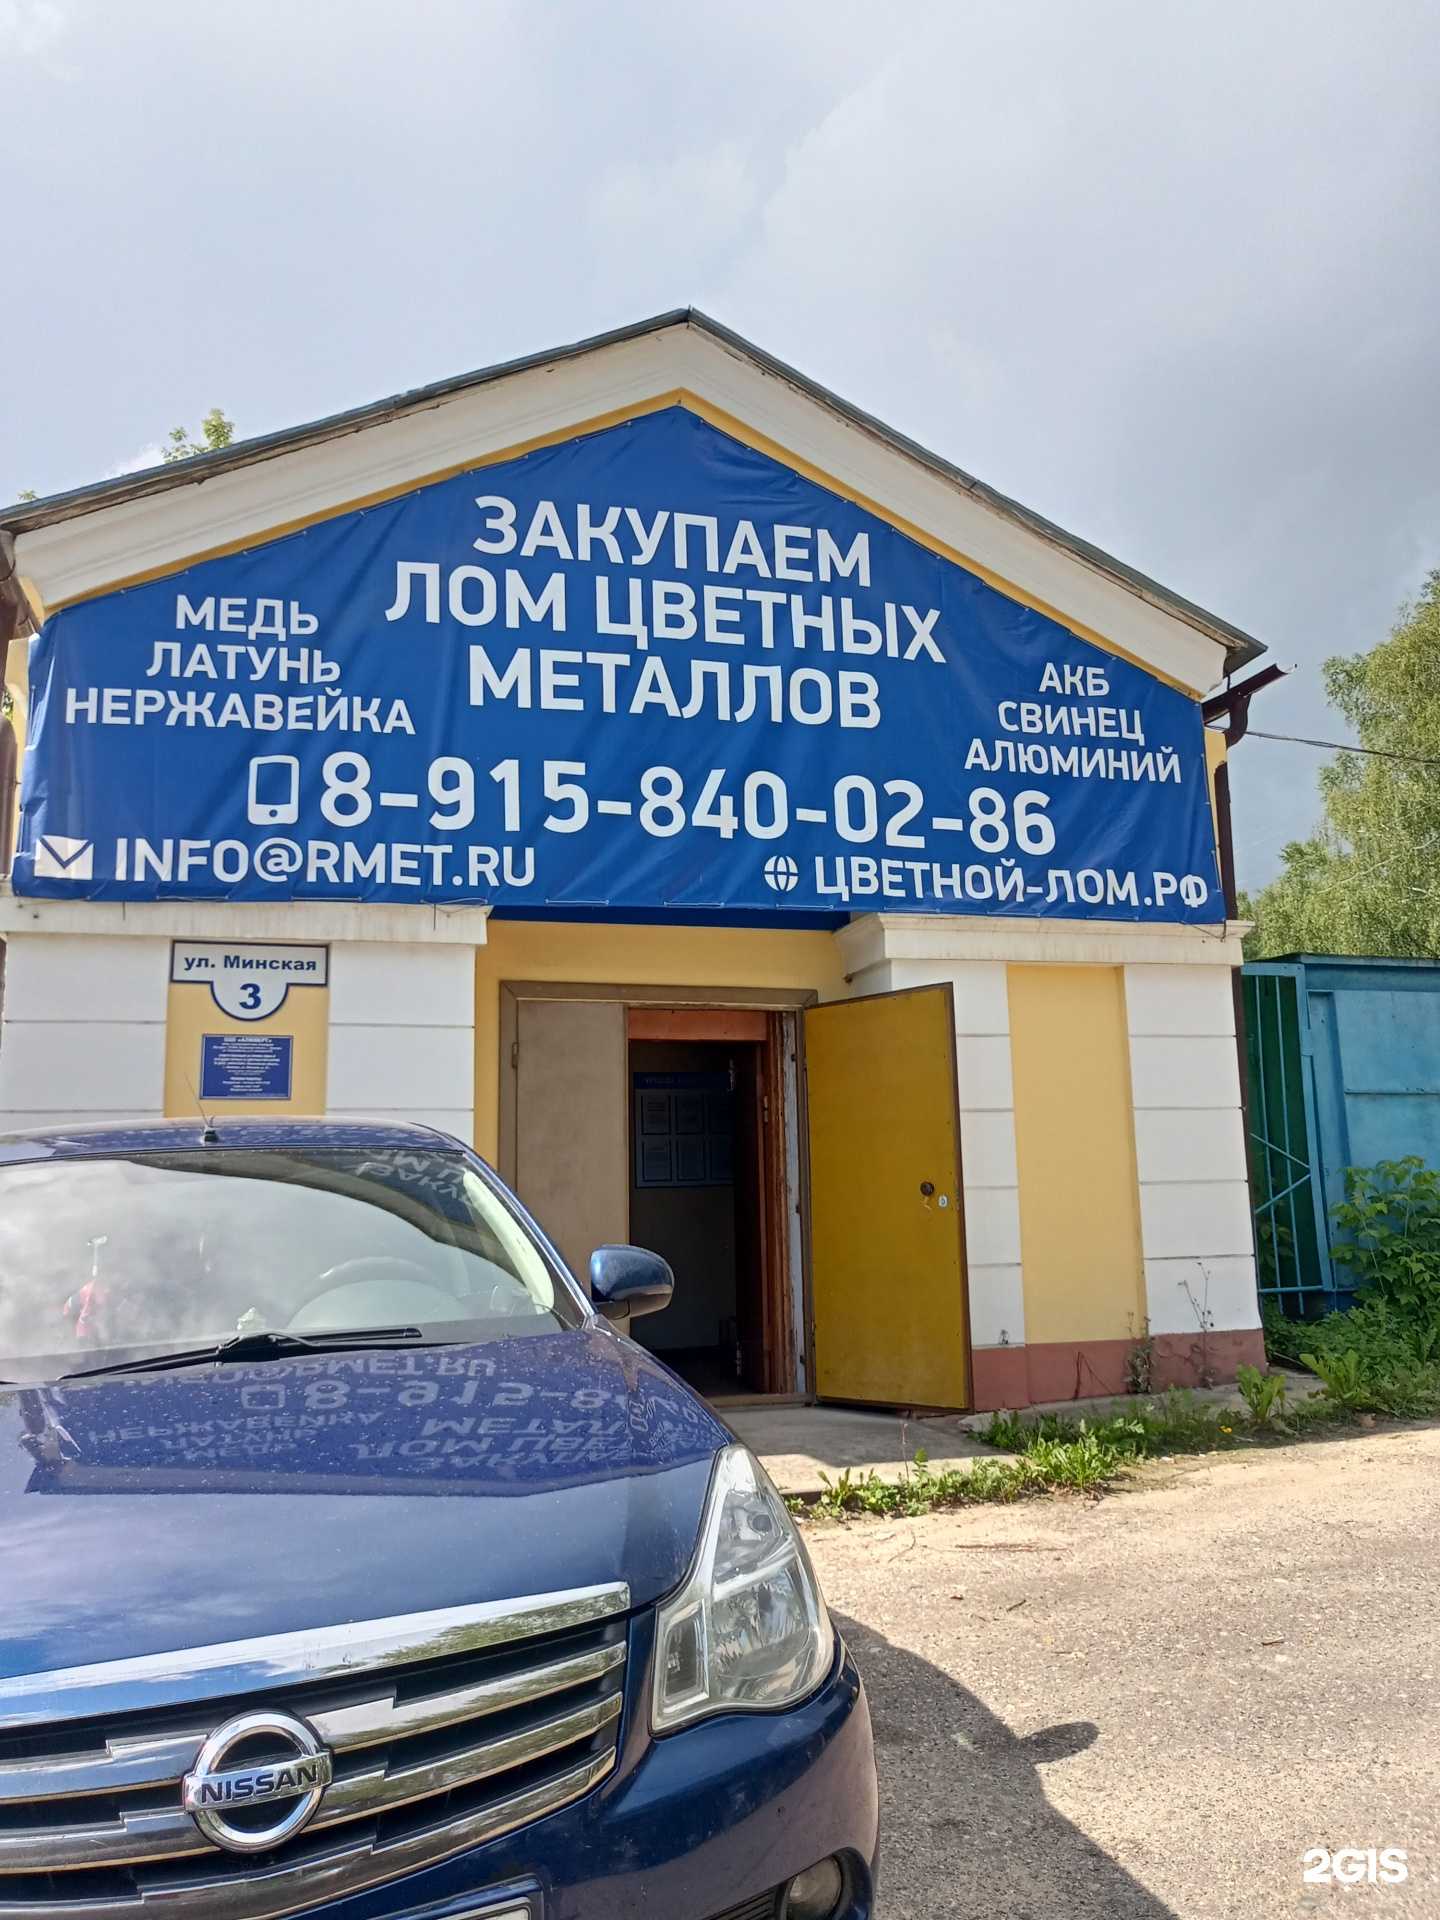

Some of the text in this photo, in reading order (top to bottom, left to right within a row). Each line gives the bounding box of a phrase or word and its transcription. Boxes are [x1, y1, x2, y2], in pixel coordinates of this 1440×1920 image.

[472, 495, 871, 587] ЗАКУПАЕМ
[176, 594, 319, 642] МЕДЬ
[385, 560, 946, 664] ЛОМ ЦВЕТНЫХ
[146, 641, 341, 684] ЛАТУНЬ
[469, 644, 881, 729] МЕТАЛЛОВ
[1038, 662, 1110, 697] АКБ
[65, 687, 416, 735] НЕРЖАВЕЙКА
[998, 701, 1145, 746] СВИНЕЦ
[964, 738, 1182, 784] АЛЮМИНИЙ
[320, 751, 1056, 855] 8-915-840-02-86
[115, 837, 535, 887] INFO@RMET.RU
[815, 856, 1208, 908] ЦВЕТНОЙ-ЛОМ.РФ
[184, 955, 317, 971] ул. Минская
[239, 983, 262, 1010] 3
[201, 1763, 318, 1803] NISSAN
